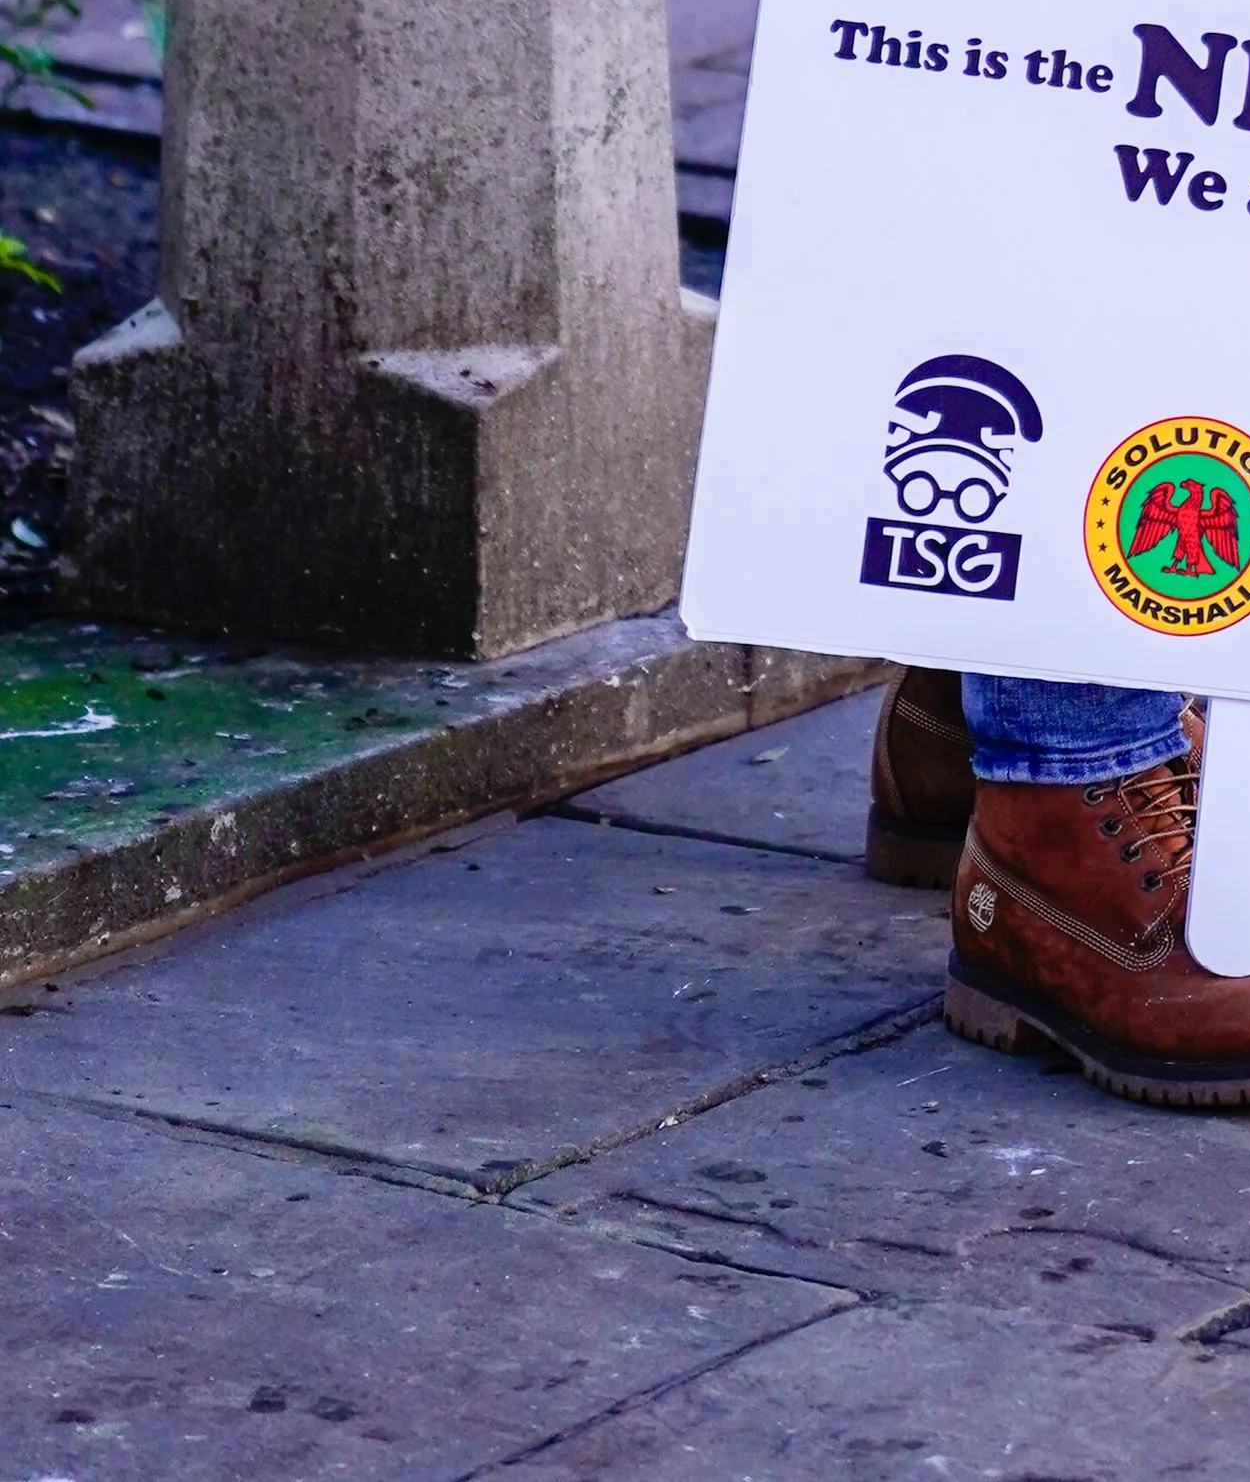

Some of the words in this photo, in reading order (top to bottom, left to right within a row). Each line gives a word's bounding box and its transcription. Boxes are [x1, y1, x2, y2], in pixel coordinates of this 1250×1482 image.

[831, 20, 949, 71] This
[963, 38, 1008, 79] is
[1024, 50, 1113, 92] the
[1114, 145, 1227, 210] We
[882, 526, 1003, 593] TSG
